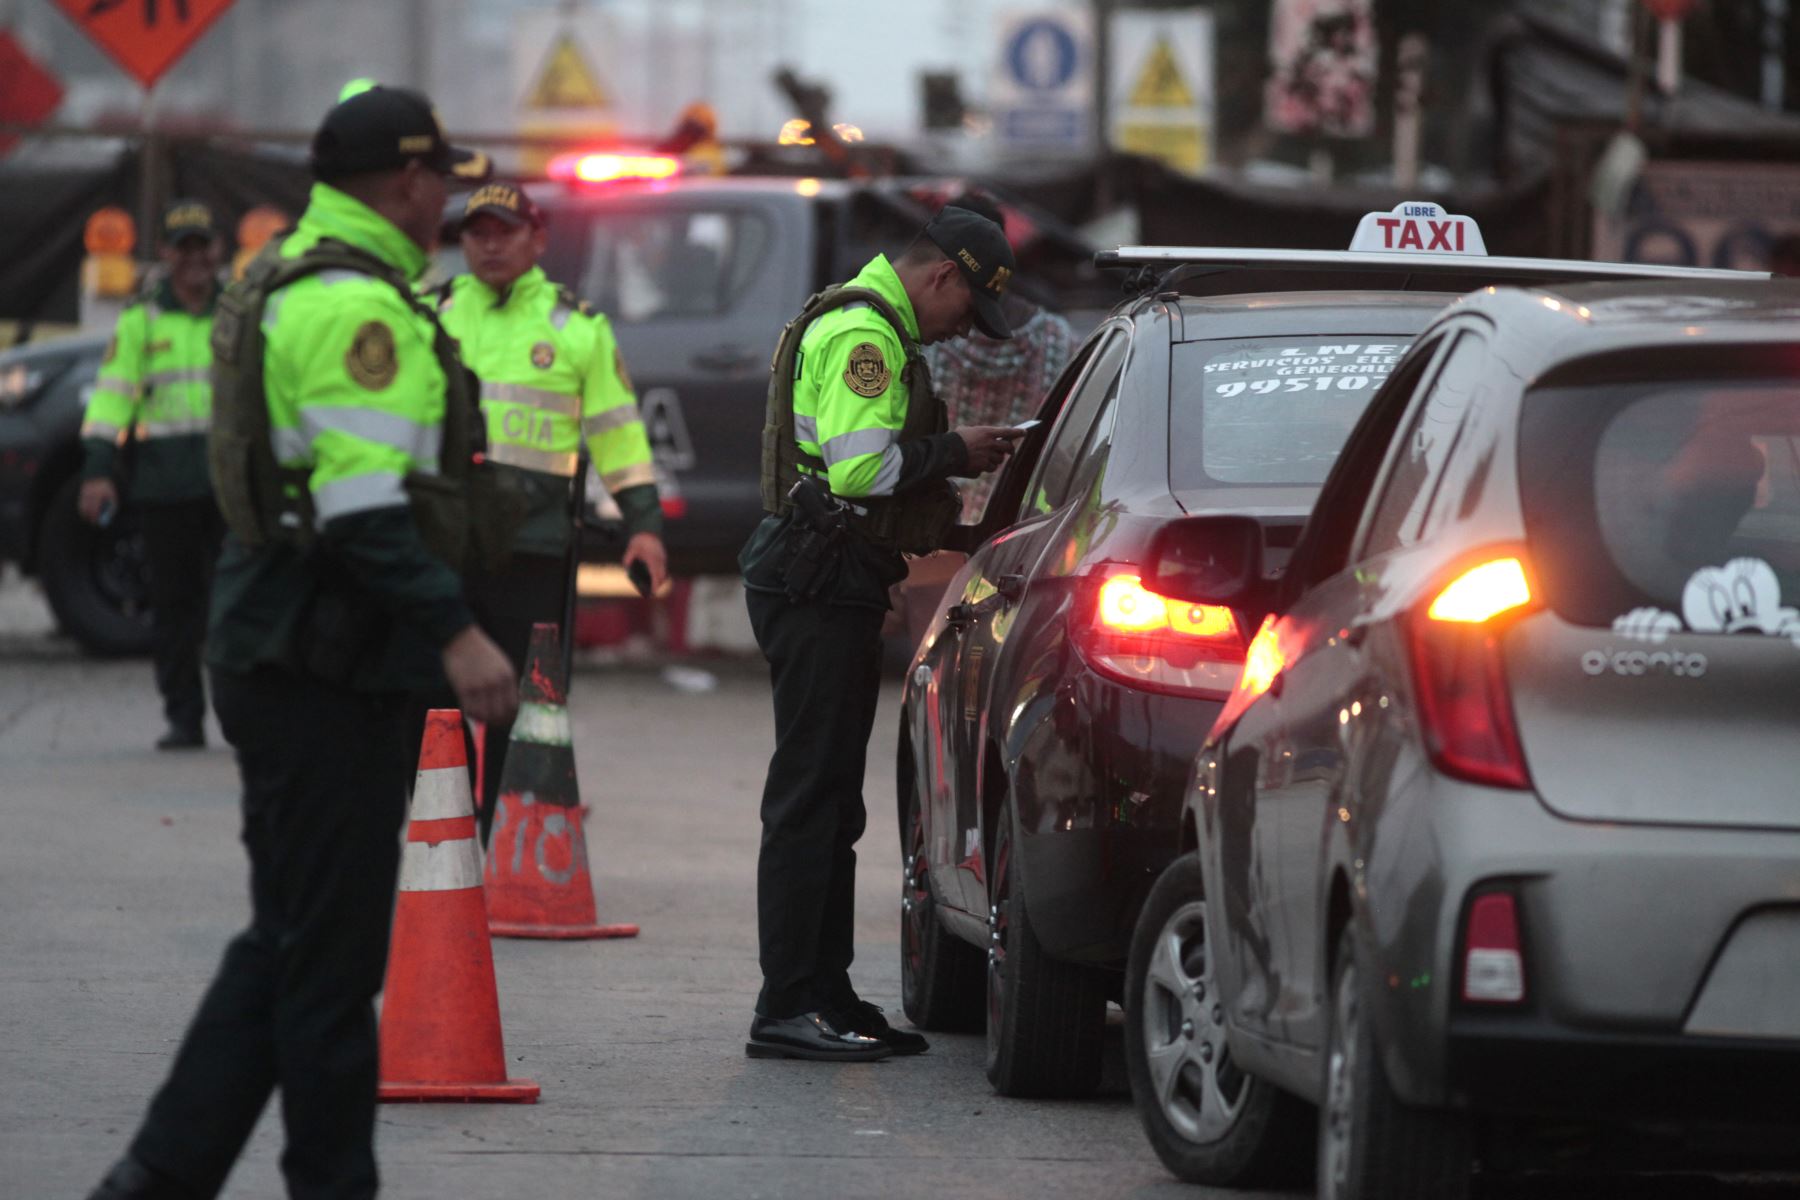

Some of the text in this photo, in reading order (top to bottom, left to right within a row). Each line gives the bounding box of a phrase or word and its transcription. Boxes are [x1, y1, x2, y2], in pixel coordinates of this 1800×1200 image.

[1403, 206, 1436, 217] LIBRE
[1376, 217, 1465, 252] TAXI
[1203, 355, 1336, 373] SERVICIOS
